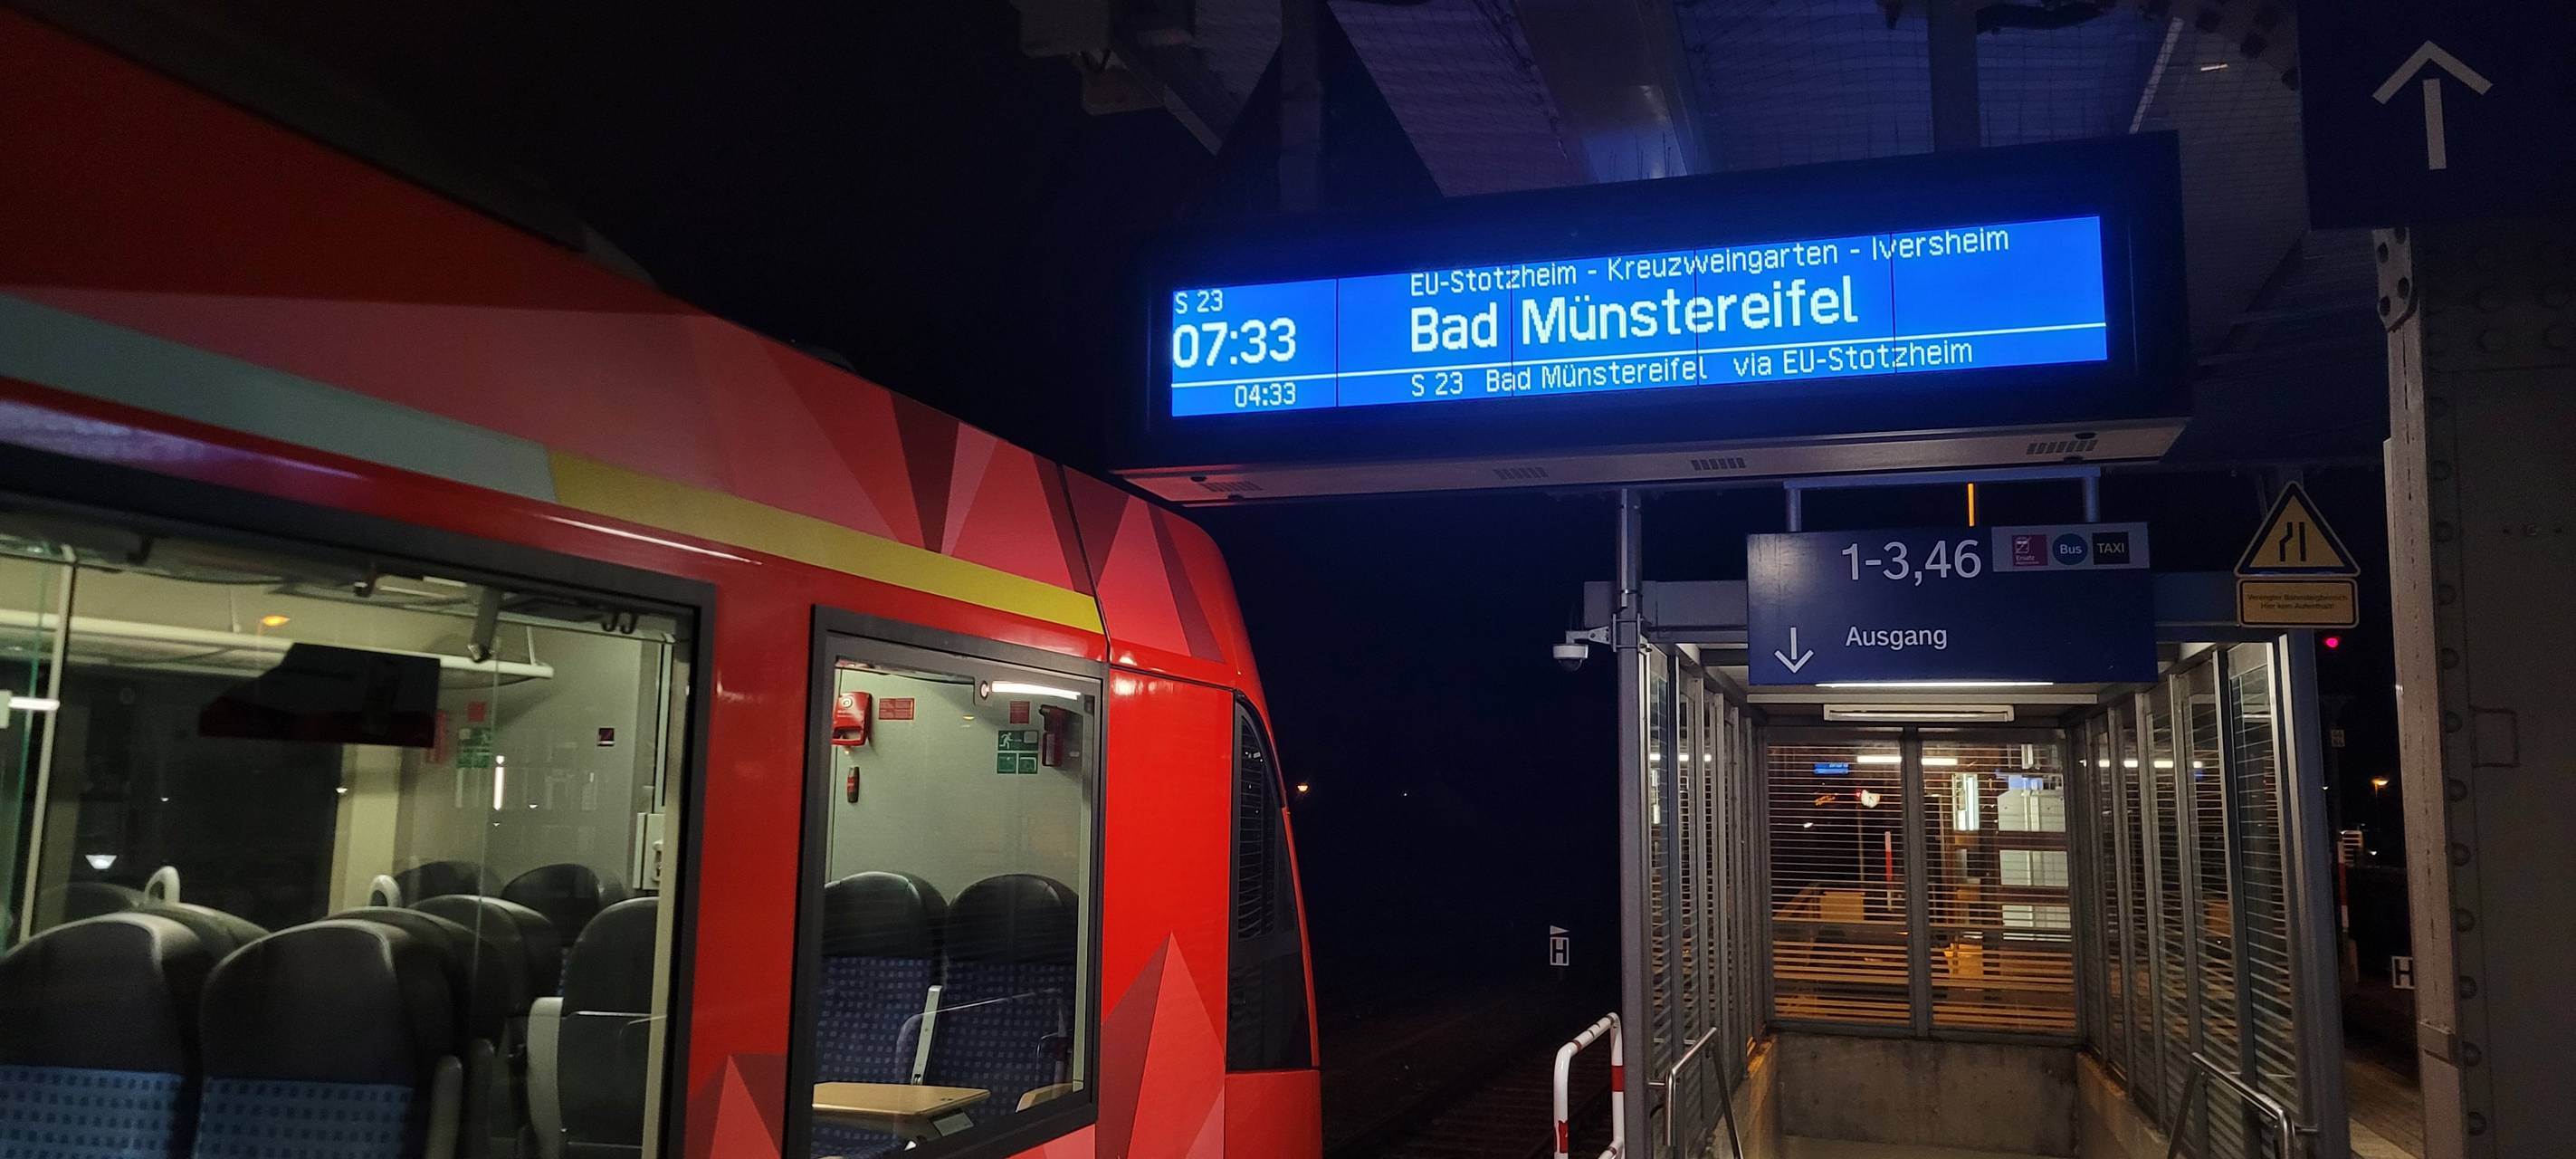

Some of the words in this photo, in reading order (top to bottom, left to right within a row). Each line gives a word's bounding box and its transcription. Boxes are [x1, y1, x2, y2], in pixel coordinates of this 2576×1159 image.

[1411, 263, 1578, 297] EU-Stotzheim
[1608, 241, 1838, 282] Kreuzweingarten
[1872, 226, 2010, 261] Iversheim
[1176, 292, 1188, 314] S
[1197, 290, 1224, 312] 23
[1411, 302, 1499, 352] Bad
[1522, 274, 1859, 345] Münstereifel
[1172, 318, 1296, 368] 07:33
[1411, 376, 1425, 397] S
[1435, 372, 1463, 395] 23
[1486, 366, 1531, 393] Bad
[1541, 356, 1708, 388] Münstereifel
[1732, 353, 1772, 378] via
[1783, 340, 1973, 375] EU-Stotzheim
[1236, 382, 1296, 407] 04:33
[2059, 543, 2083, 555] Bus
[2097, 542, 2124, 555] TAXI
[1841, 540, 1982, 586] 1-3,46
[1846, 626, 1947, 649] Ausgang
[1552, 939, 1567, 963] H
[2395, 959, 2414, 985] H
